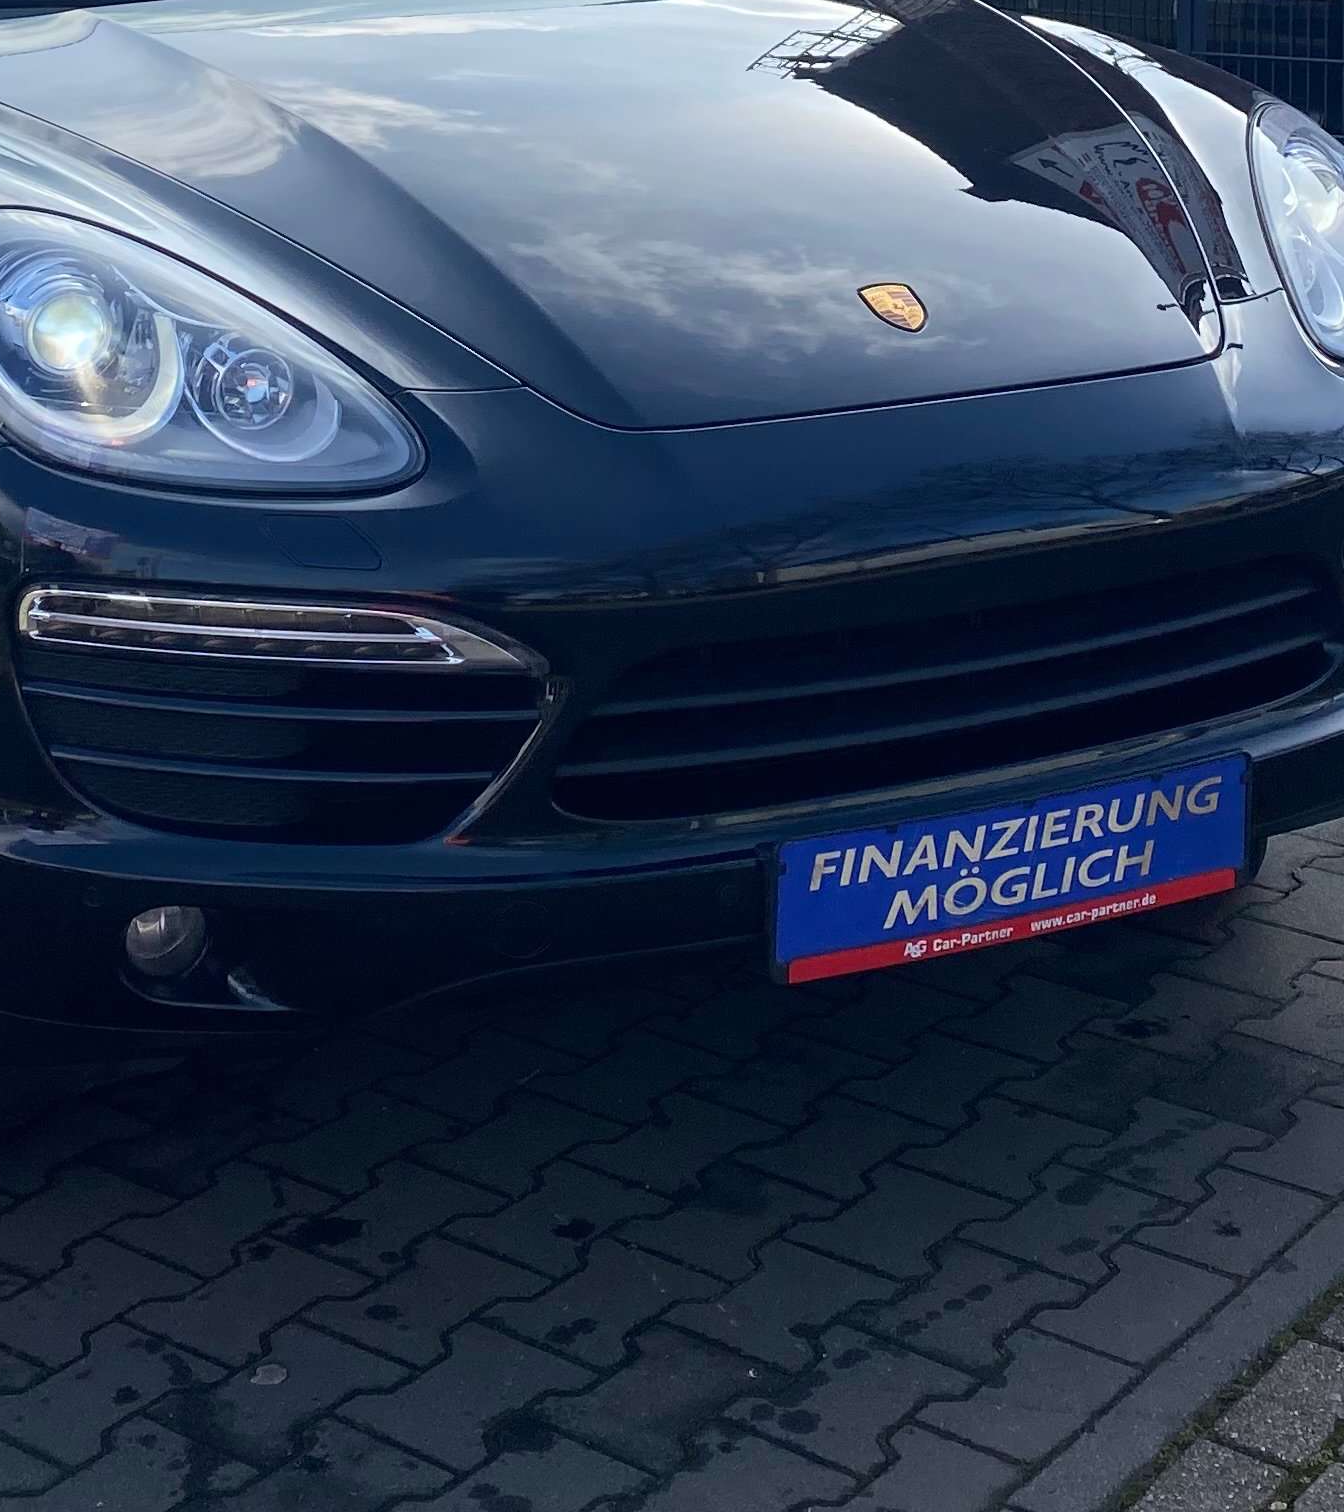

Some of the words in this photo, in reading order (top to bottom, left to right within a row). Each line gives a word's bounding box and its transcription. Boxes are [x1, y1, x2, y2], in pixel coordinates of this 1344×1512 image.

[809, 776, 1223, 891] FINANZIERUNG
[882, 838, 1156, 929] MÖGLICH
[933, 927, 1014, 952] Car-Partner
[1030, 892, 1157, 932] www.car-partner.de
